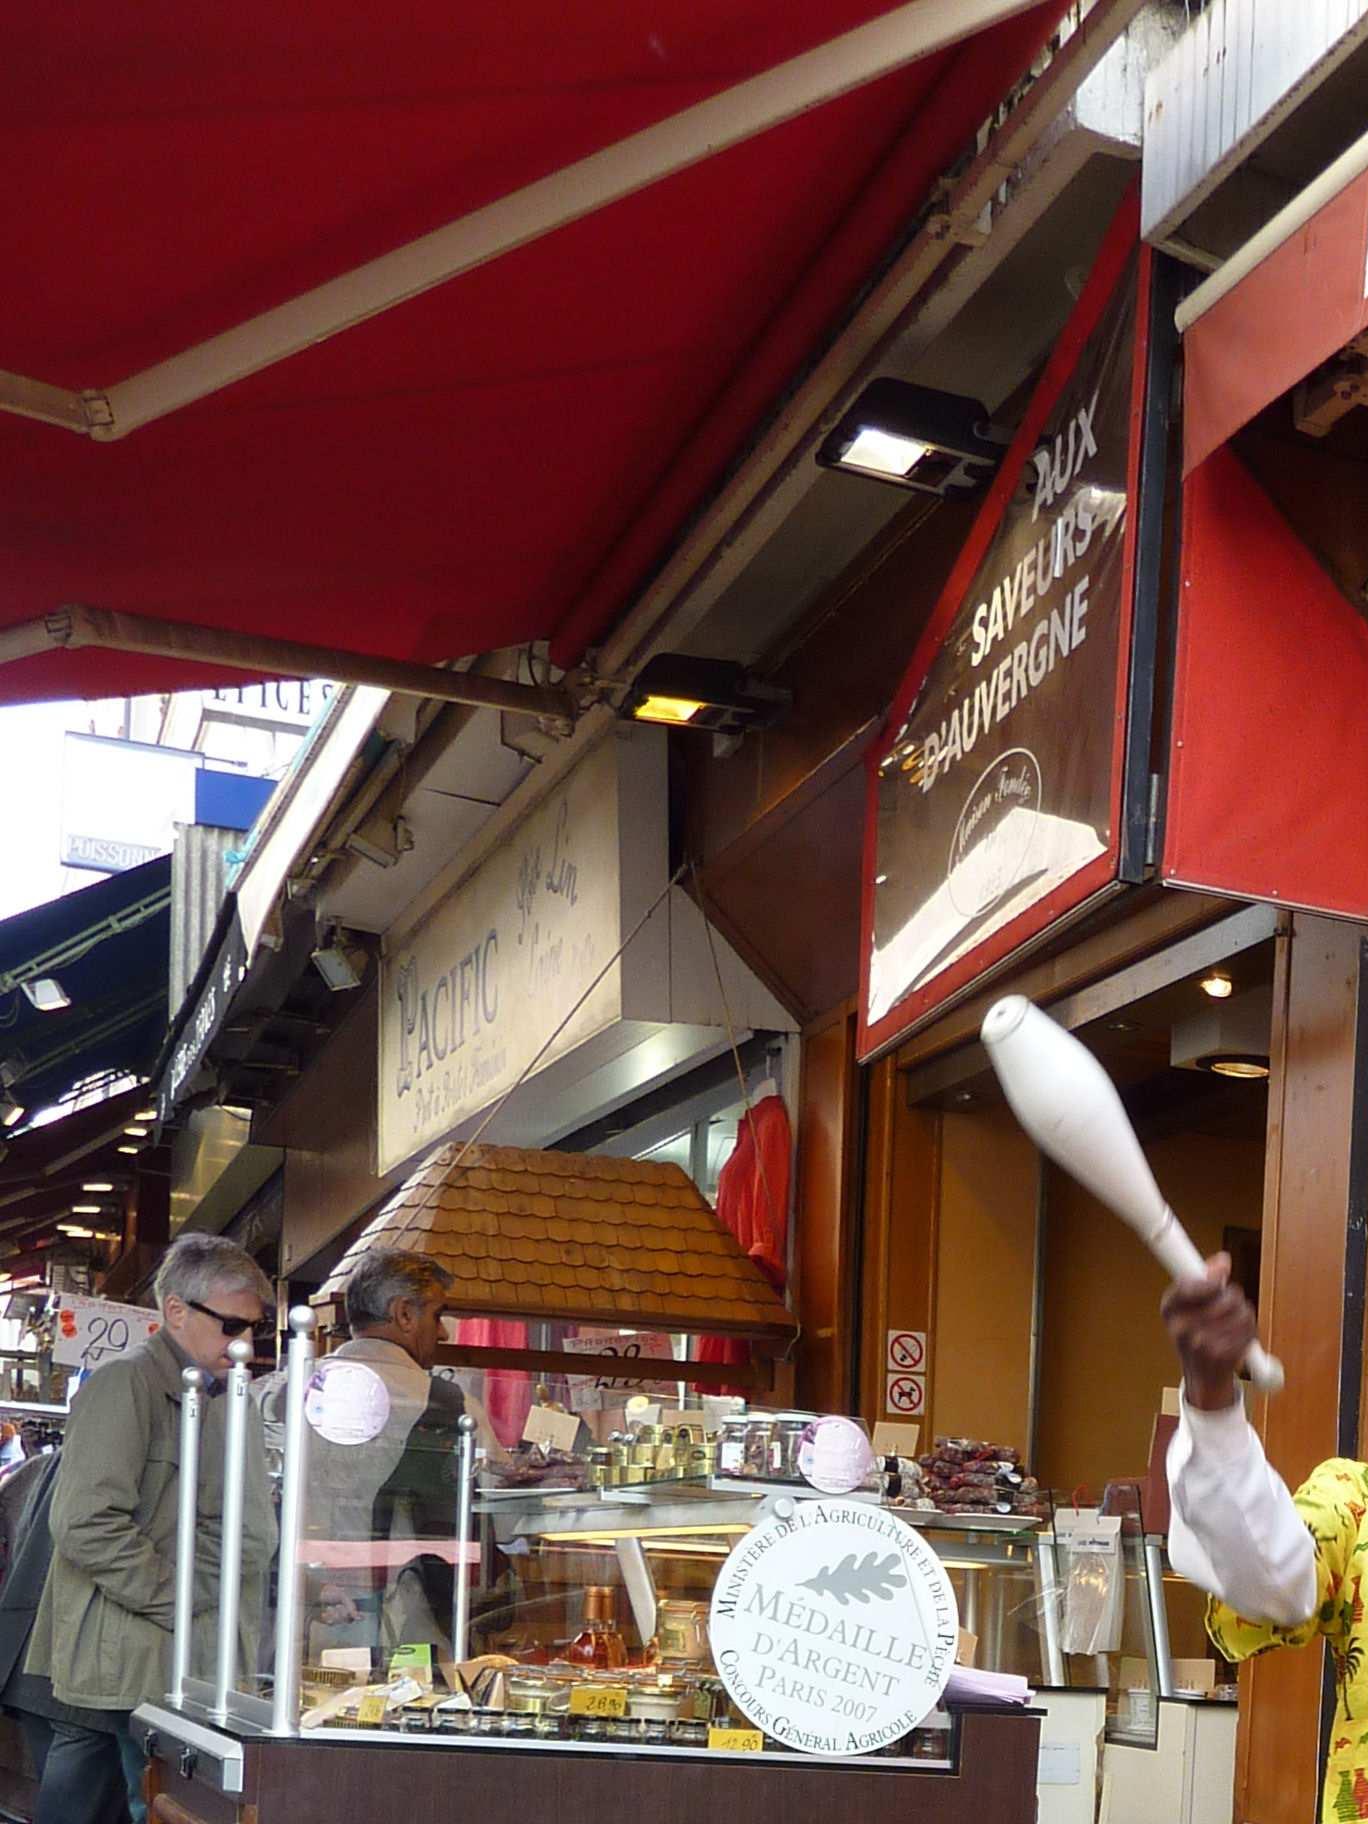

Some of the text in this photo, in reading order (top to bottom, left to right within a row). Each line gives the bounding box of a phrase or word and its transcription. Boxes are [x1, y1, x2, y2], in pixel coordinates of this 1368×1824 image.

[1032, 390, 1099, 523] AUX
[970, 487, 1093, 667] SAVEURS
[920, 576, 1090, 793] D'AUVERGNE
[397, 928, 499, 1099] PACIFIC
[775, 1518, 798, 1539] DE
[917, 1555, 936, 1577] ET
[744, 1583, 928, 1670] MÉDAILLE
[928, 1581, 945, 1602] DE
[935, 1607, 949, 1627] LA
[719, 1649, 772, 1725] CONCOURS
[846, 1710, 918, 1751] AGRICOLE
[751, 1631, 900, 1698] D'ARGENT
[755, 1664, 879, 1724] PARIS 2007
